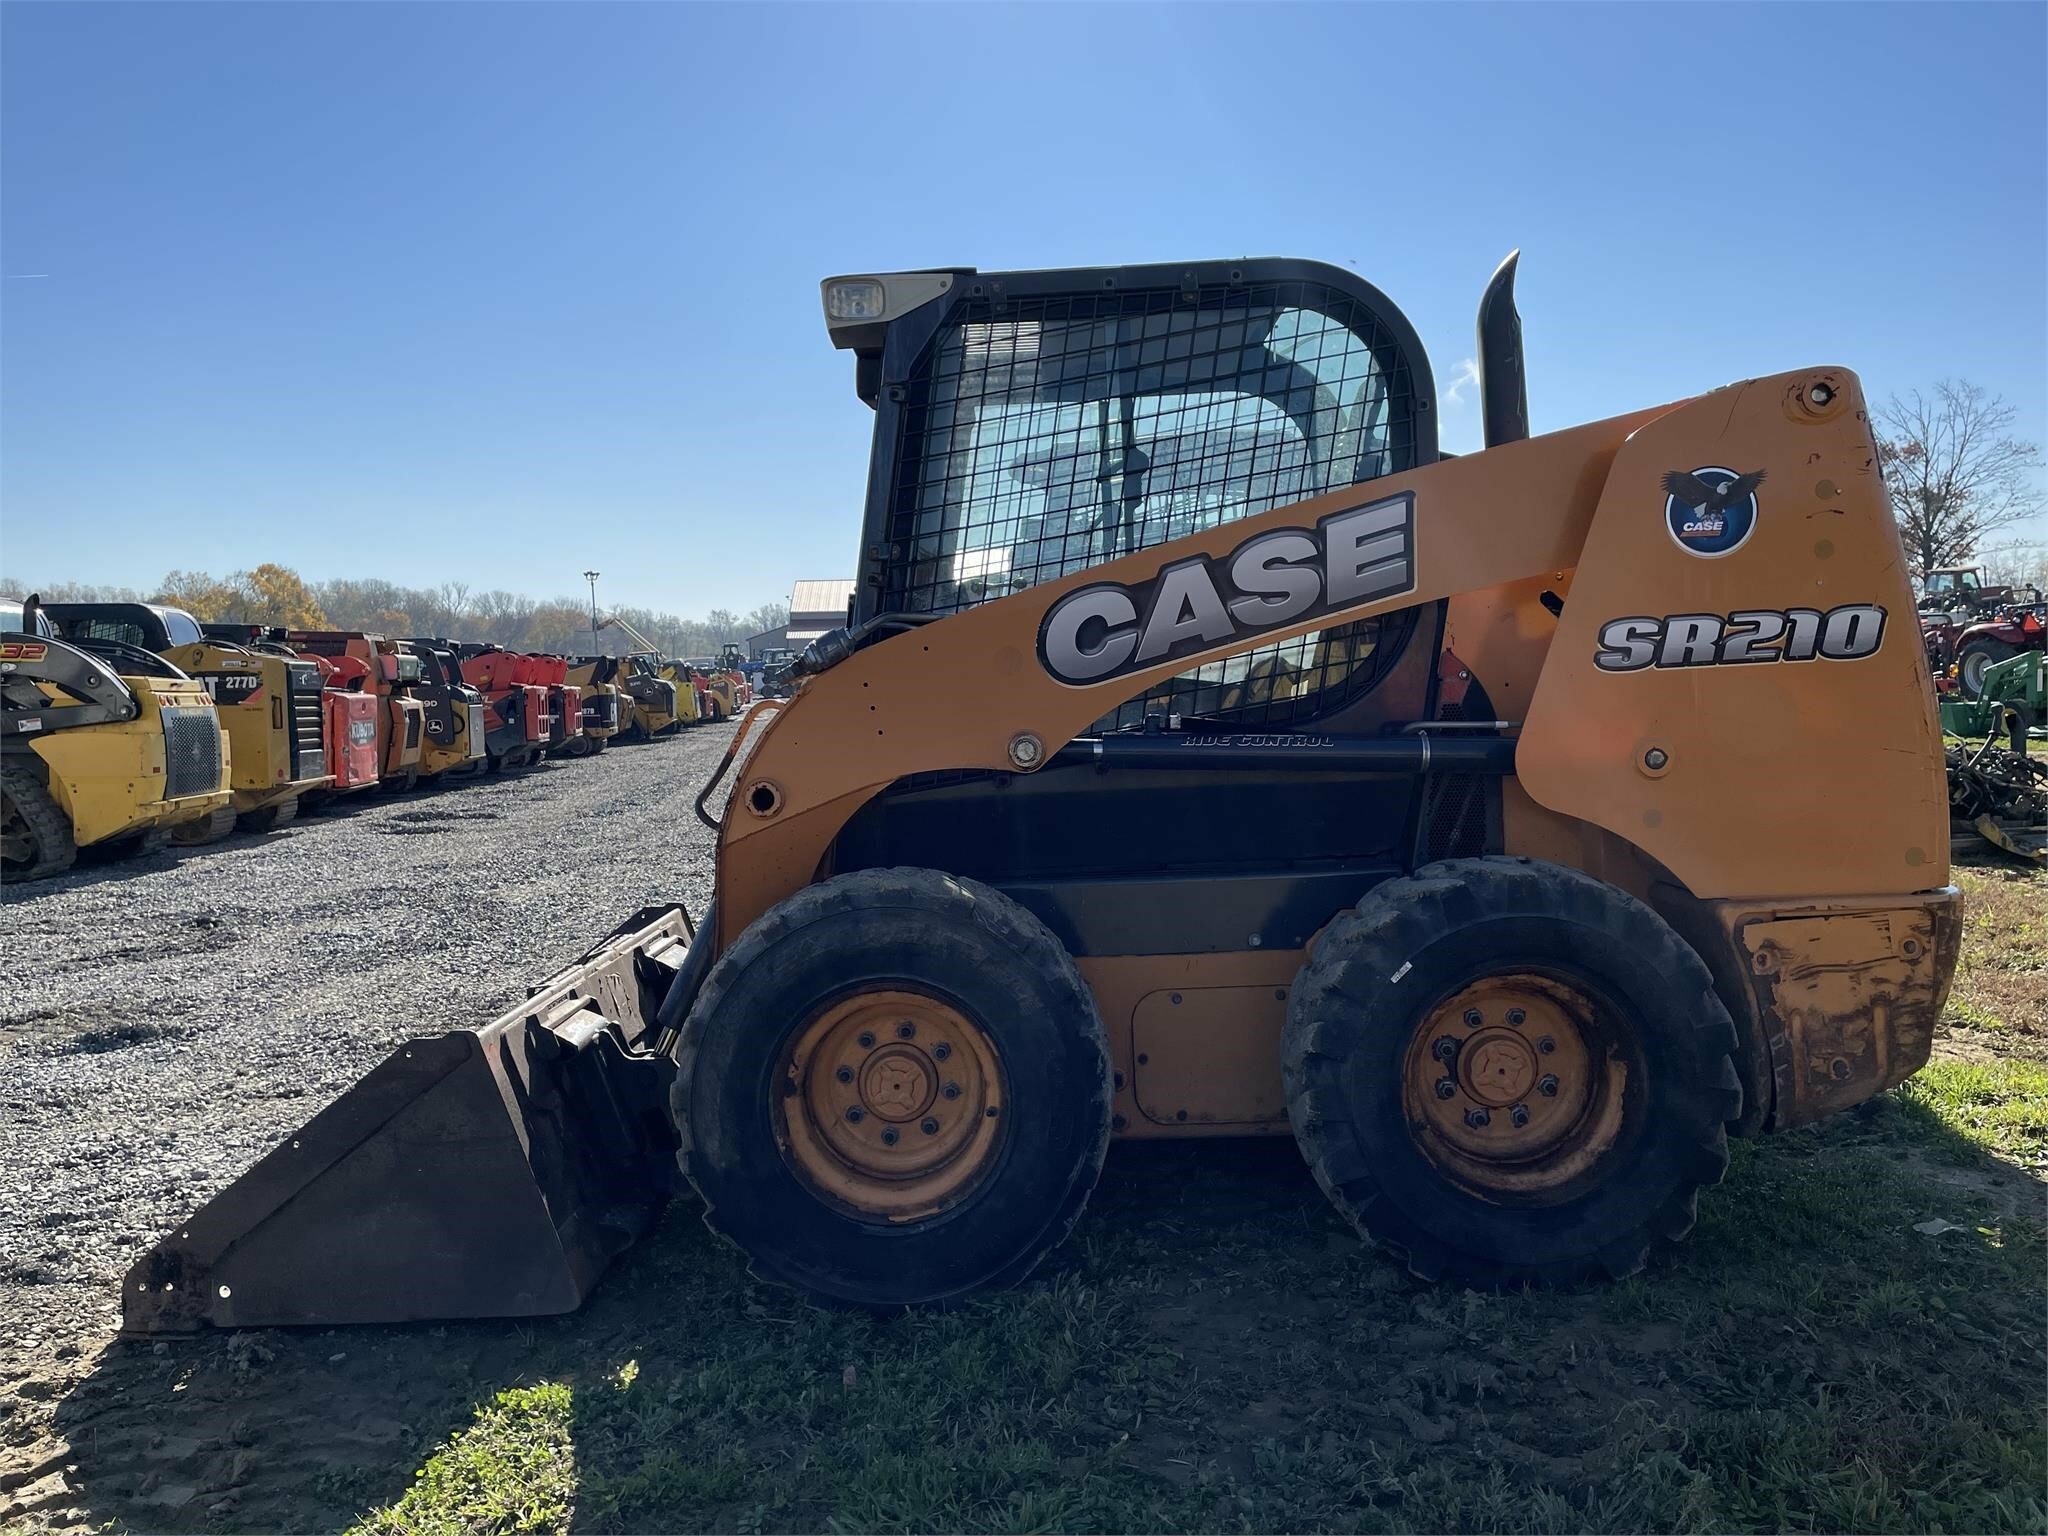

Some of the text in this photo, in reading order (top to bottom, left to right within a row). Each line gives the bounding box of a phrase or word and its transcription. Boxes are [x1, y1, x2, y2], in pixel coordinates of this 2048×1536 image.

[1683, 521, 1723, 532] CASE
[1041, 494, 1413, 684] CASE
[1595, 604, 1887, 671] SR210
[226, 677, 257, 689] 277D
[351, 722, 375, 739] KUBOTA
[1181, 735, 1334, 747] RIDE CONTROL
